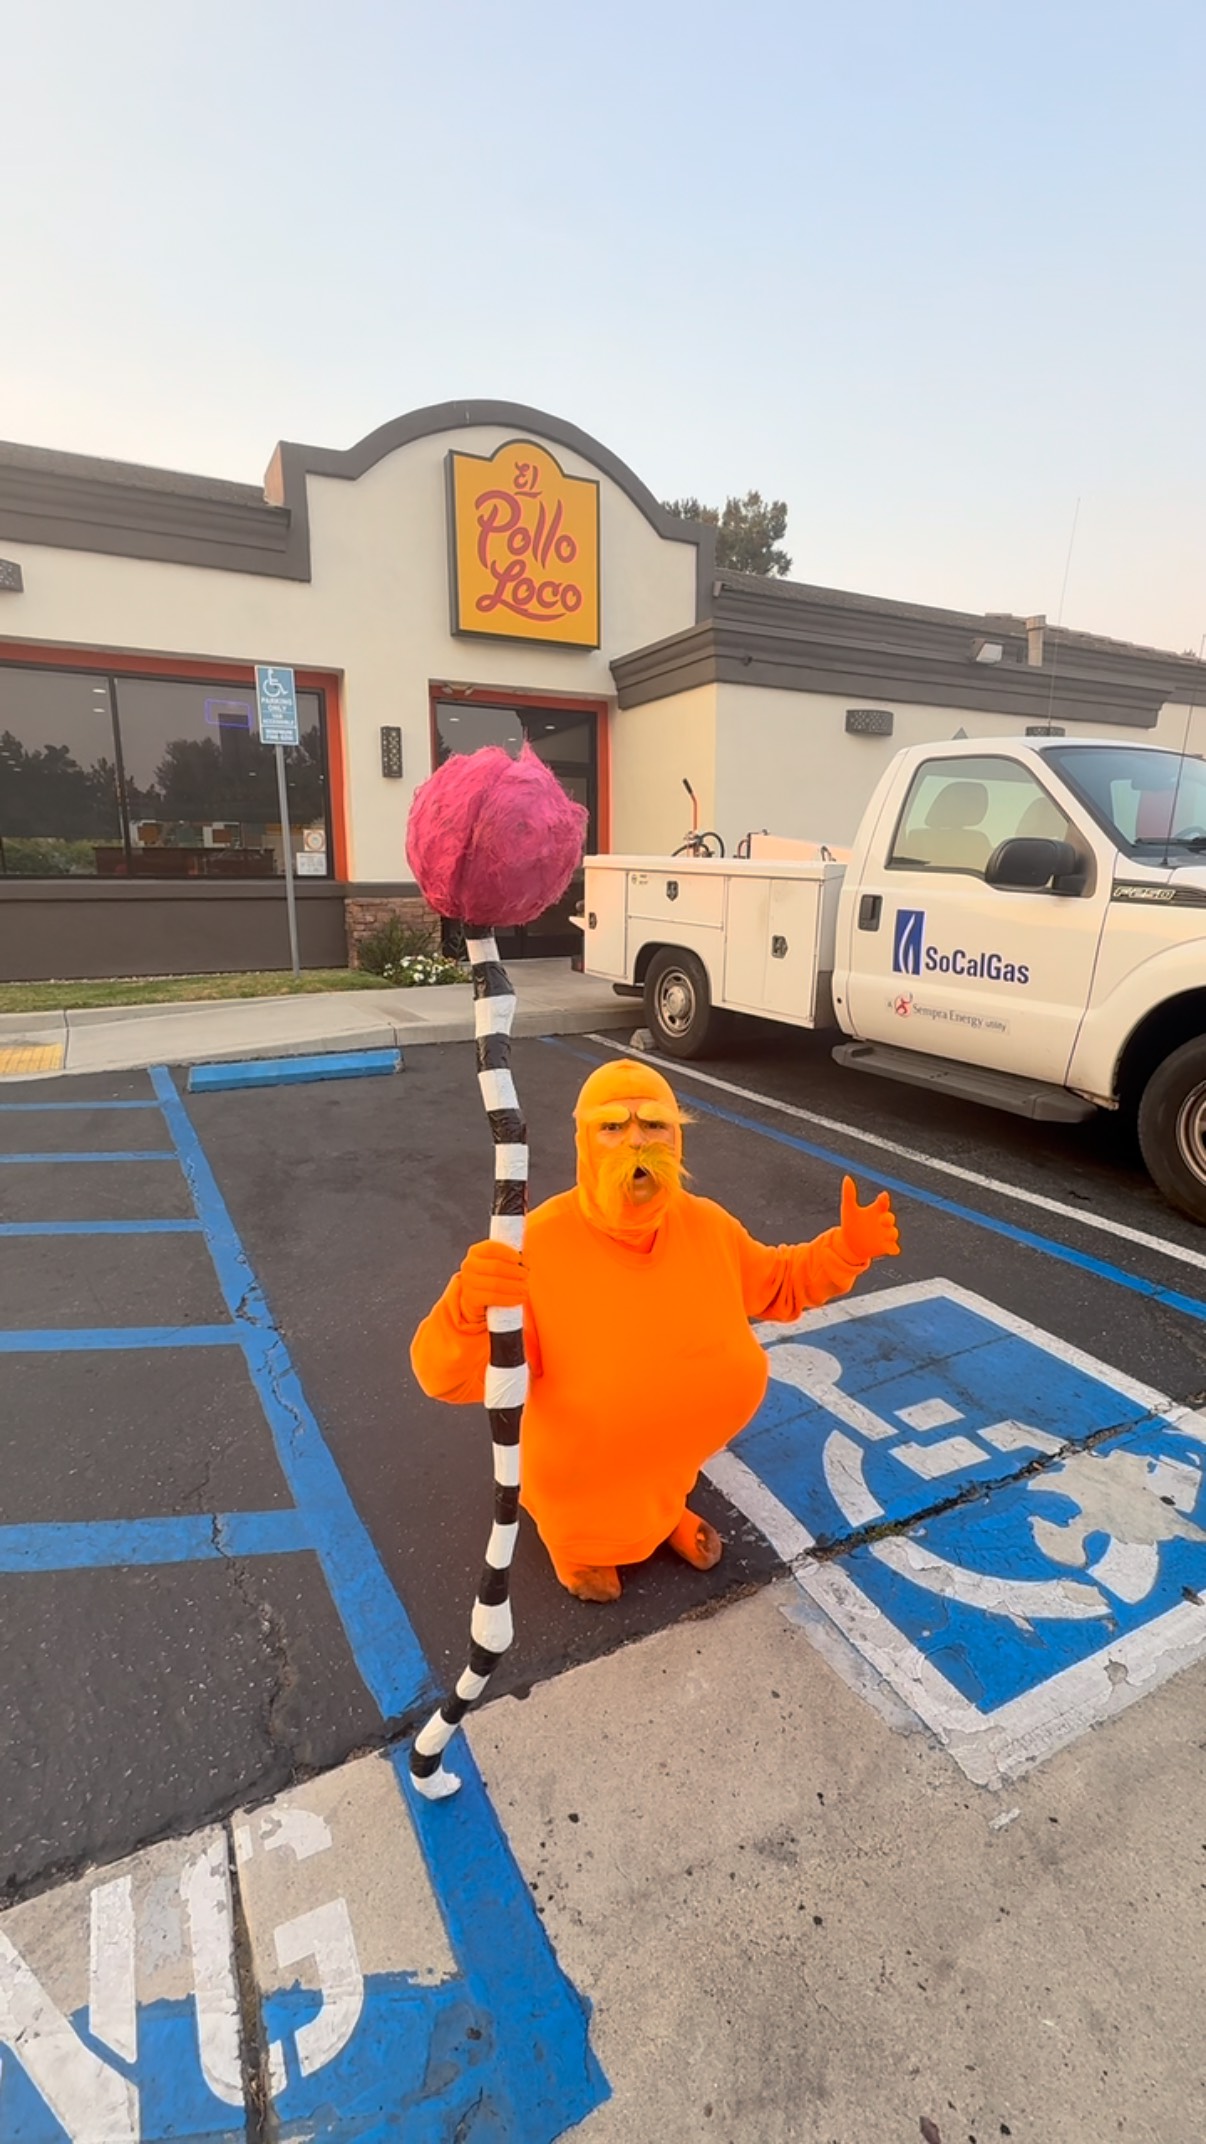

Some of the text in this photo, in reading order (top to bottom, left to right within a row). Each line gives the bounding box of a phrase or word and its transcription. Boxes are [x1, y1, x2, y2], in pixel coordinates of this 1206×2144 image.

[513, 461, 542, 498] El
[474, 489, 577, 570] Pollo
[474, 558, 582, 622] Loco
[261, 697, 292, 706] PARKING
[925, 945, 1030, 984] SoCalGas
[912, 1003, 948, 1020] Sempra
[949, 1010, 983, 1028] Energy
